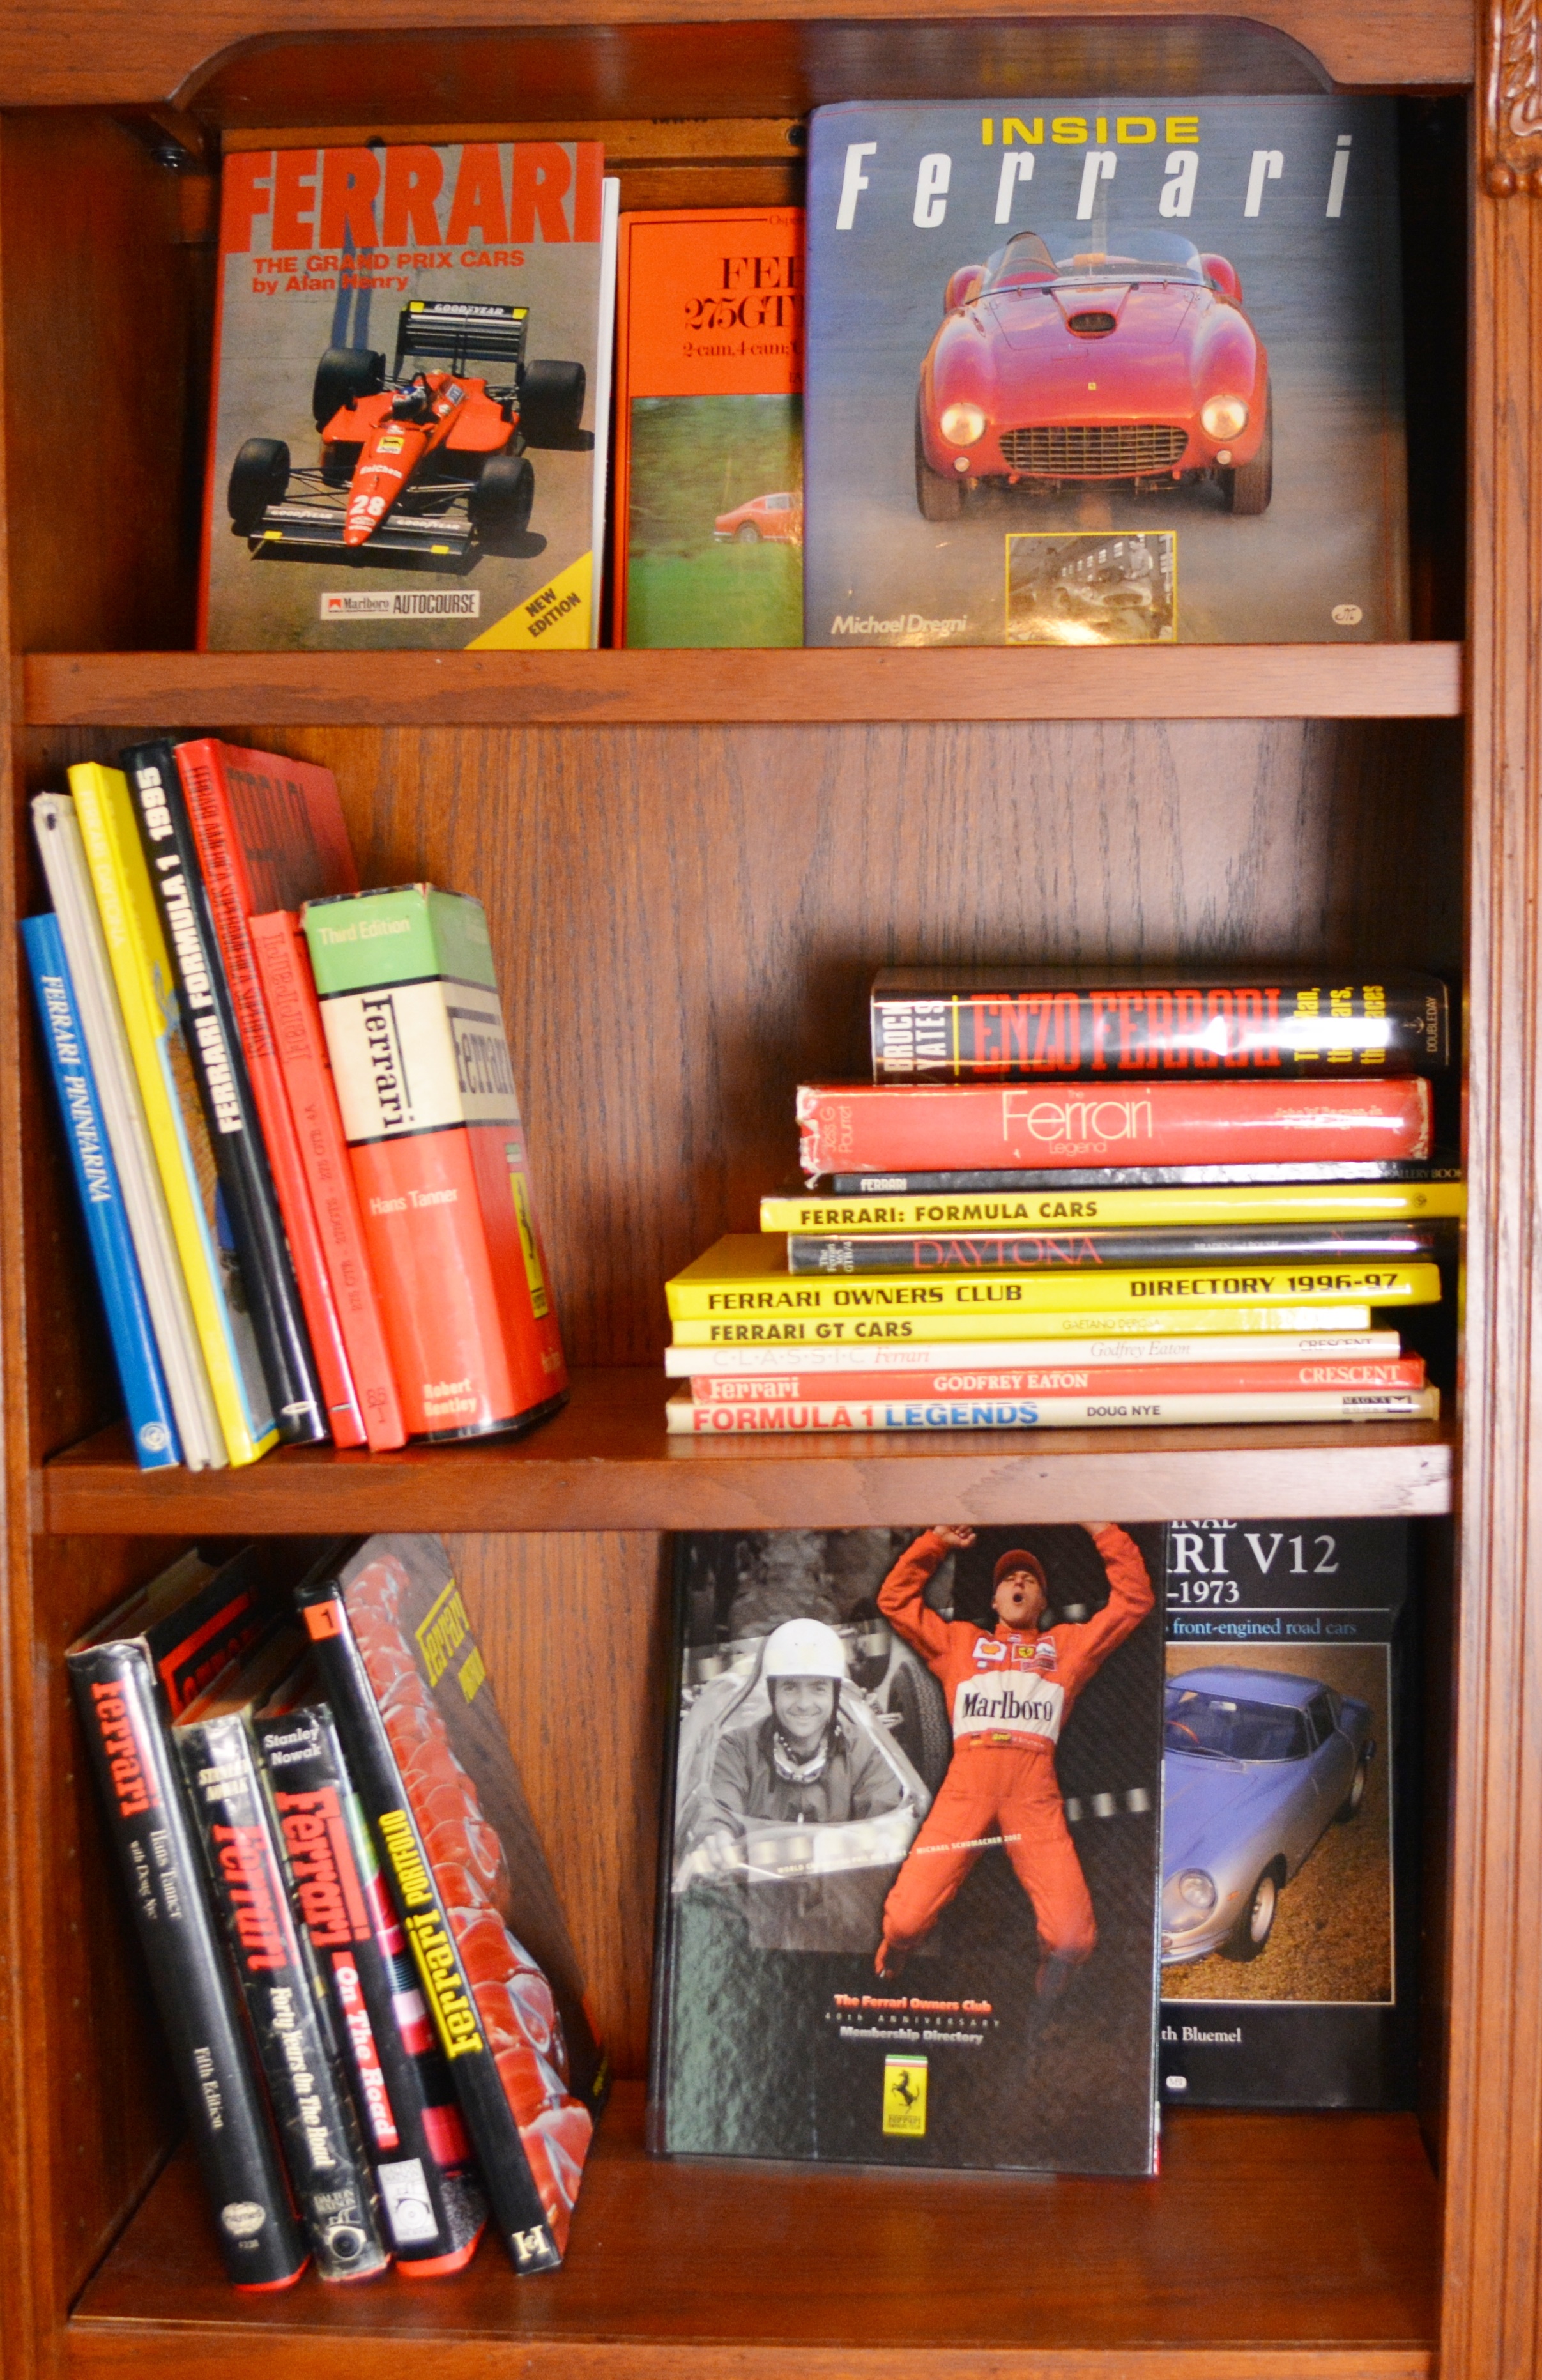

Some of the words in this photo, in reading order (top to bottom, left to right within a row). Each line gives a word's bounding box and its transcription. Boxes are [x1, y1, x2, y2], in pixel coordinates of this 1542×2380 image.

[982, 116, 1200, 146] INSIDE
[219, 141, 605, 254] FERRARI
[836, 134, 1353, 231] Ferrari
[253, 257, 298, 274] THE
[306, 254, 389, 272] GRAND
[397, 252, 453, 268] PRIX
[460, 250, 524, 267] CARS
[252, 277, 279, 295] by
[286, 275, 335, 291] Alan
[342, 273, 408, 291] Henry
[434, 303, 505, 316] GOODYEAR
[685, 295, 804, 330] 275GT
[350, 495, 385, 516] 28
[344, 597, 389, 610] Marlboro
[393, 594, 475, 614] AUTOCOURSE
[525, 588, 556, 617] NEW
[528, 592, 581, 638] EDITION
[831, 615, 905, 634] Michael
[906, 615, 968, 634] Dregni
[136, 767, 174, 841] 1995
[156, 854, 181, 871] 1
[160, 873, 217, 1009] FORMULA
[319, 926, 357, 945] Third
[360, 916, 410, 941] Edition
[257, 931, 312, 1064] Ferrari
[882, 1002, 914, 1072] BROCK
[915, 1001, 947, 1071] YATES
[970, 992, 1081, 1073] ENZO
[1089, 988, 1281, 1071] FERRARI
[1427, 996, 1438, 1052] DOUBLEDAY
[195, 1013, 243, 1134] FERRARI
[362, 994, 415, 1129] Ferrari
[42, 976, 80, 1065] FERRARI
[65, 1075, 111, 1202] PININFARINA
[1002, 1087, 1152, 1141] Ferrari
[1049, 1140, 1108, 1156] Legend
[860, 1178, 907, 1191] FERRARI
[370, 1197, 408, 1215] Hans
[409, 1188, 458, 1208] Tanner
[801, 1208, 905, 1225] FERRARI:
[916, 1203, 1028, 1222] FORMULA
[1039, 1201, 1097, 1217] CARS
[913, 1237, 1103, 1269] DAYTONA
[708, 1291, 820, 1310] FERRARI
[834, 1287, 943, 1305] OWNERS
[958, 1285, 1022, 1302] CLUB
[1131, 1277, 1275, 1296] DIRECTORY
[1288, 1273, 1399, 1293] 1996-97
[710, 1324, 805, 1340] FERRARI
[816, 1323, 844, 1338] GT
[855, 1321, 913, 1337] CARS
[1062, 1317, 1116, 1330] GAETANO
[874, 1346, 931, 1365] Ferrari
[1090, 1341, 1145, 1359] Godfrey
[1148, 1340, 1191, 1356] Eaton
[424, 1379, 471, 1399] Robert
[709, 1376, 799, 1399] Ferrari
[933, 1374, 1021, 1391] GODFREY
[1027, 1372, 1089, 1390] EATON
[1299, 1365, 1400, 1383] CRESCENT
[424, 1397, 477, 1418] Bentley
[693, 1407, 845, 1431] FORMULA
[862, 1407, 873, 1427] 1
[885, 1402, 1039, 1427] LEGENDS
[1087, 1405, 1127, 1417] DOUG
[1131, 1404, 1161, 1416] NYE
[1244, 1533, 1340, 1574] V12
[1173, 1618, 1281, 1638] front-engined
[1286, 1618, 1321, 1635] road
[1325, 1622, 1357, 1635] cars
[962, 1690, 1053, 1721] Marlboro
[91, 1678, 160, 1818] Ferrari
[264, 1726, 319, 1749] Stanley
[271, 1744, 321, 1765] Nowak
[378, 1809, 434, 1907] PORTFOLIO
[916, 1844, 950, 1854] MICHAEL
[951, 1836, 1002, 1850] SCHUMACHER
[151, 1829, 169, 1867] Hans
[161, 1869, 181, 1919] Tanner
[275, 1786, 372, 1947] Ferrari
[213, 1824, 298, 1971] Ferrari
[336, 1967, 358, 2003] On
[405, 1908, 483, 2060] Ferrari
[270, 1987, 295, 2029] Forty
[834, 1993, 860, 2008] The
[862, 1995, 908, 2009] Ferrari
[910, 1997, 960, 2011] Owners
[961, 2000, 992, 2012] Club
[346, 2010, 372, 2060] The
[840, 2026, 920, 2040] Membership
[922, 2029, 984, 2045] Directory
[878, 2014, 1000, 2027] ANNIVERSARY
[1182, 2026, 1242, 2042] Bluemel
[194, 2046, 214, 2079] Fifth
[282, 2031, 306, 2076] Years
[293, 2073, 314, 2095] On
[202, 2080, 224, 2130] Edition
[298, 2095, 321, 2128] The
[362, 2067, 396, 2135] Road
[306, 2128, 335, 2168] Road
